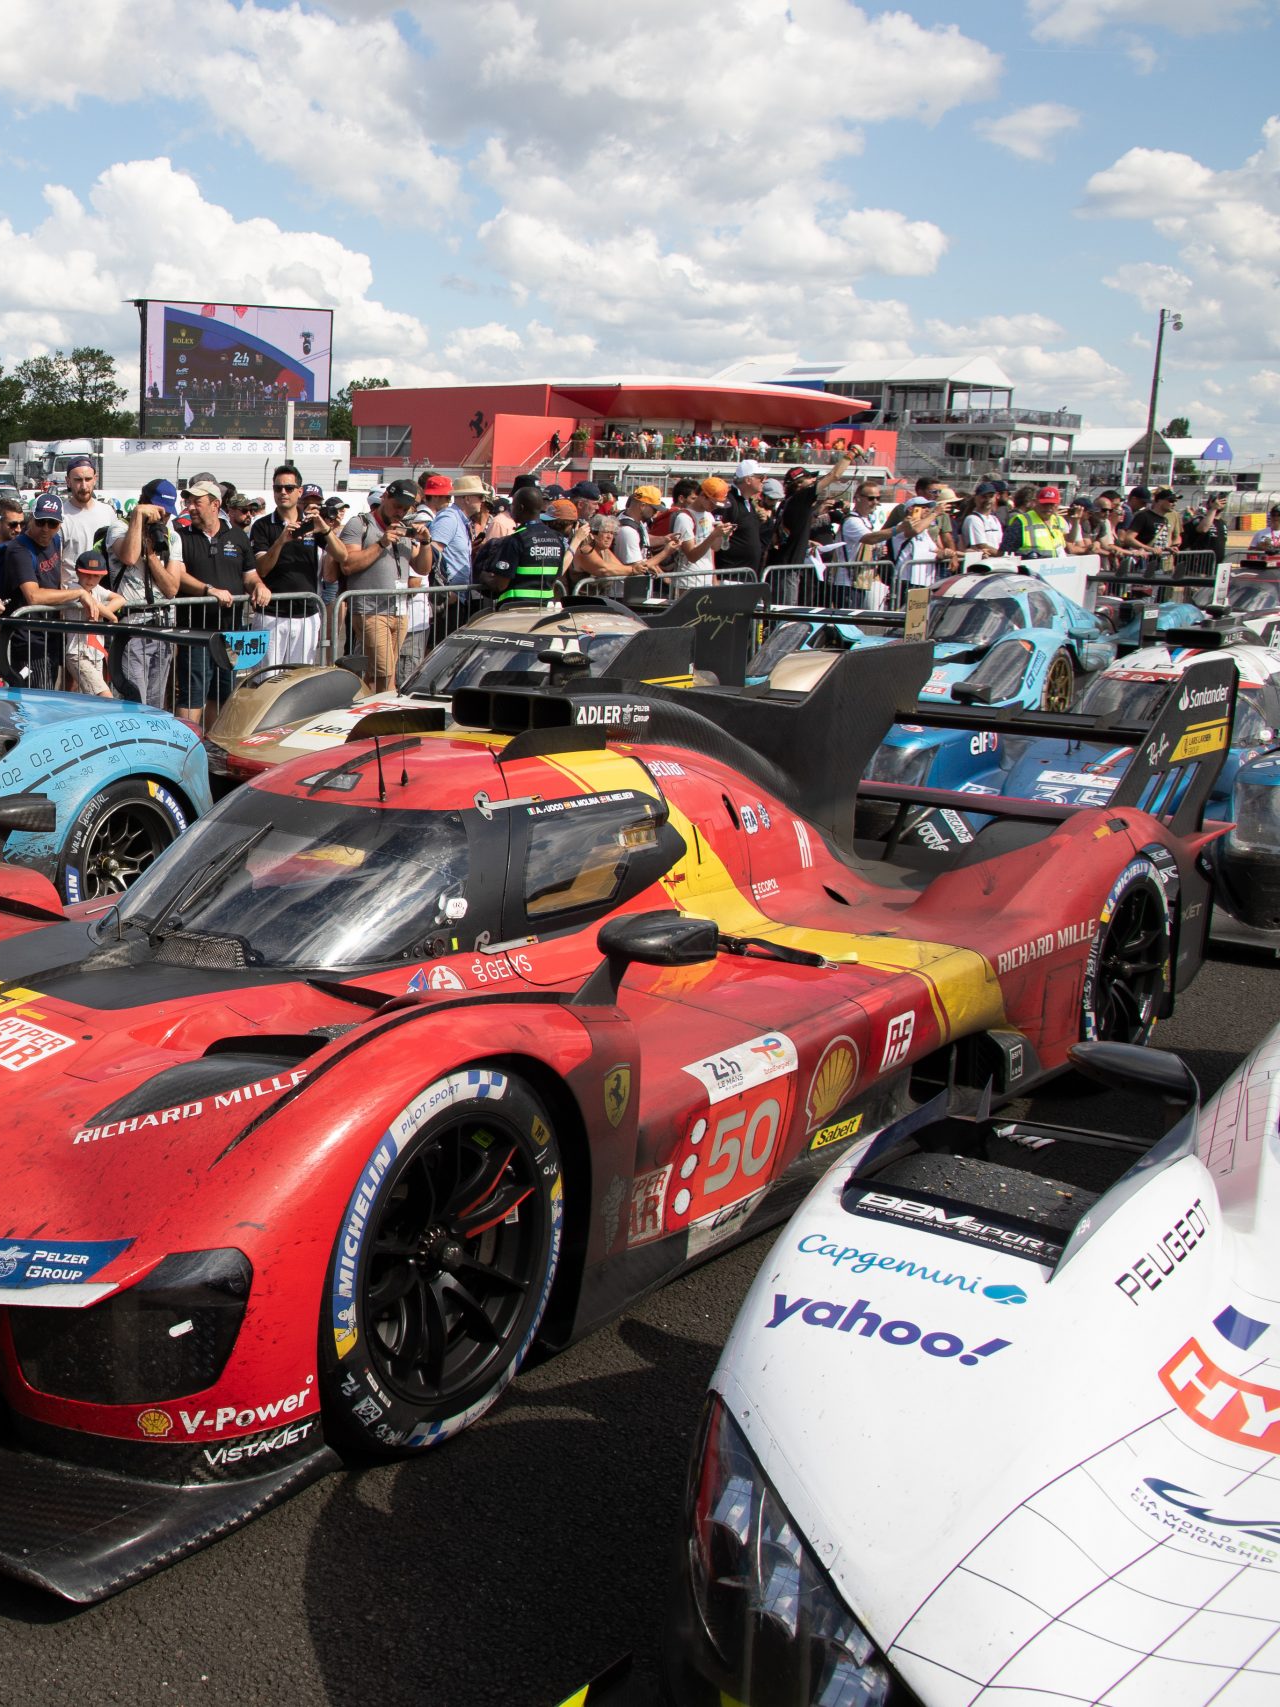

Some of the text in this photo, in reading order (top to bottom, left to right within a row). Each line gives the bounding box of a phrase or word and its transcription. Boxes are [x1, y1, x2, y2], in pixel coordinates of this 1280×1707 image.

[172, 337, 194, 345] ROLEX
[43, 500, 58, 511] 24h
[448, 633, 535, 648] PORSCHE
[1189, 684, 1229, 709] Santander
[576, 705, 621, 725] ADLER
[29, 748, 54, 768] 0.2
[60, 734, 84, 753] 2.0
[90, 723, 110, 741] 20
[116, 718, 140, 733] 200
[149, 719, 171, 733] 2KW
[307, 724, 351, 736] Her
[970, 731, 989, 755] elf
[578, 797, 599, 807] MOLINA
[1032, 784, 1114, 805] 35
[165, 796, 188, 833] MICH
[757, 878, 778, 894] ECOPOL
[1114, 862, 1149, 895] MICHELIN
[997, 934, 1053, 975] RICHARD
[1057, 919, 1097, 951] MILLE
[485, 954, 533, 980] GENYS
[702, 1057, 742, 1080] 24h
[717, 1073, 744, 1089] LE MANS
[72, 1069, 309, 1145] RICHARD MILLE
[400, 1082, 461, 1135] PILOT SPORT
[816, 1117, 858, 1146] Sabelt
[703, 1098, 781, 1196] 50
[632, 1170, 666, 1199] PER
[337, 1143, 391, 1299] MICHELIN
[856, 1204, 1059, 1261] MOTORSPORT ENGINEERING
[32, 1249, 90, 1266] PELZER
[797, 1233, 982, 1296] Capgemini
[1114, 1197, 1217, 1307] PEUGEOT
[26, 1265, 83, 1281] GROUP
[764, 1293, 1014, 1367] yahoo!
[179, 1388, 311, 1436] V-Power
[203, 1424, 313, 1466] VISTAJET
[1130, 1492, 1273, 1565] CHAMPIONSHIP
[1134, 1487, 1232, 1543] FIA WORLD
